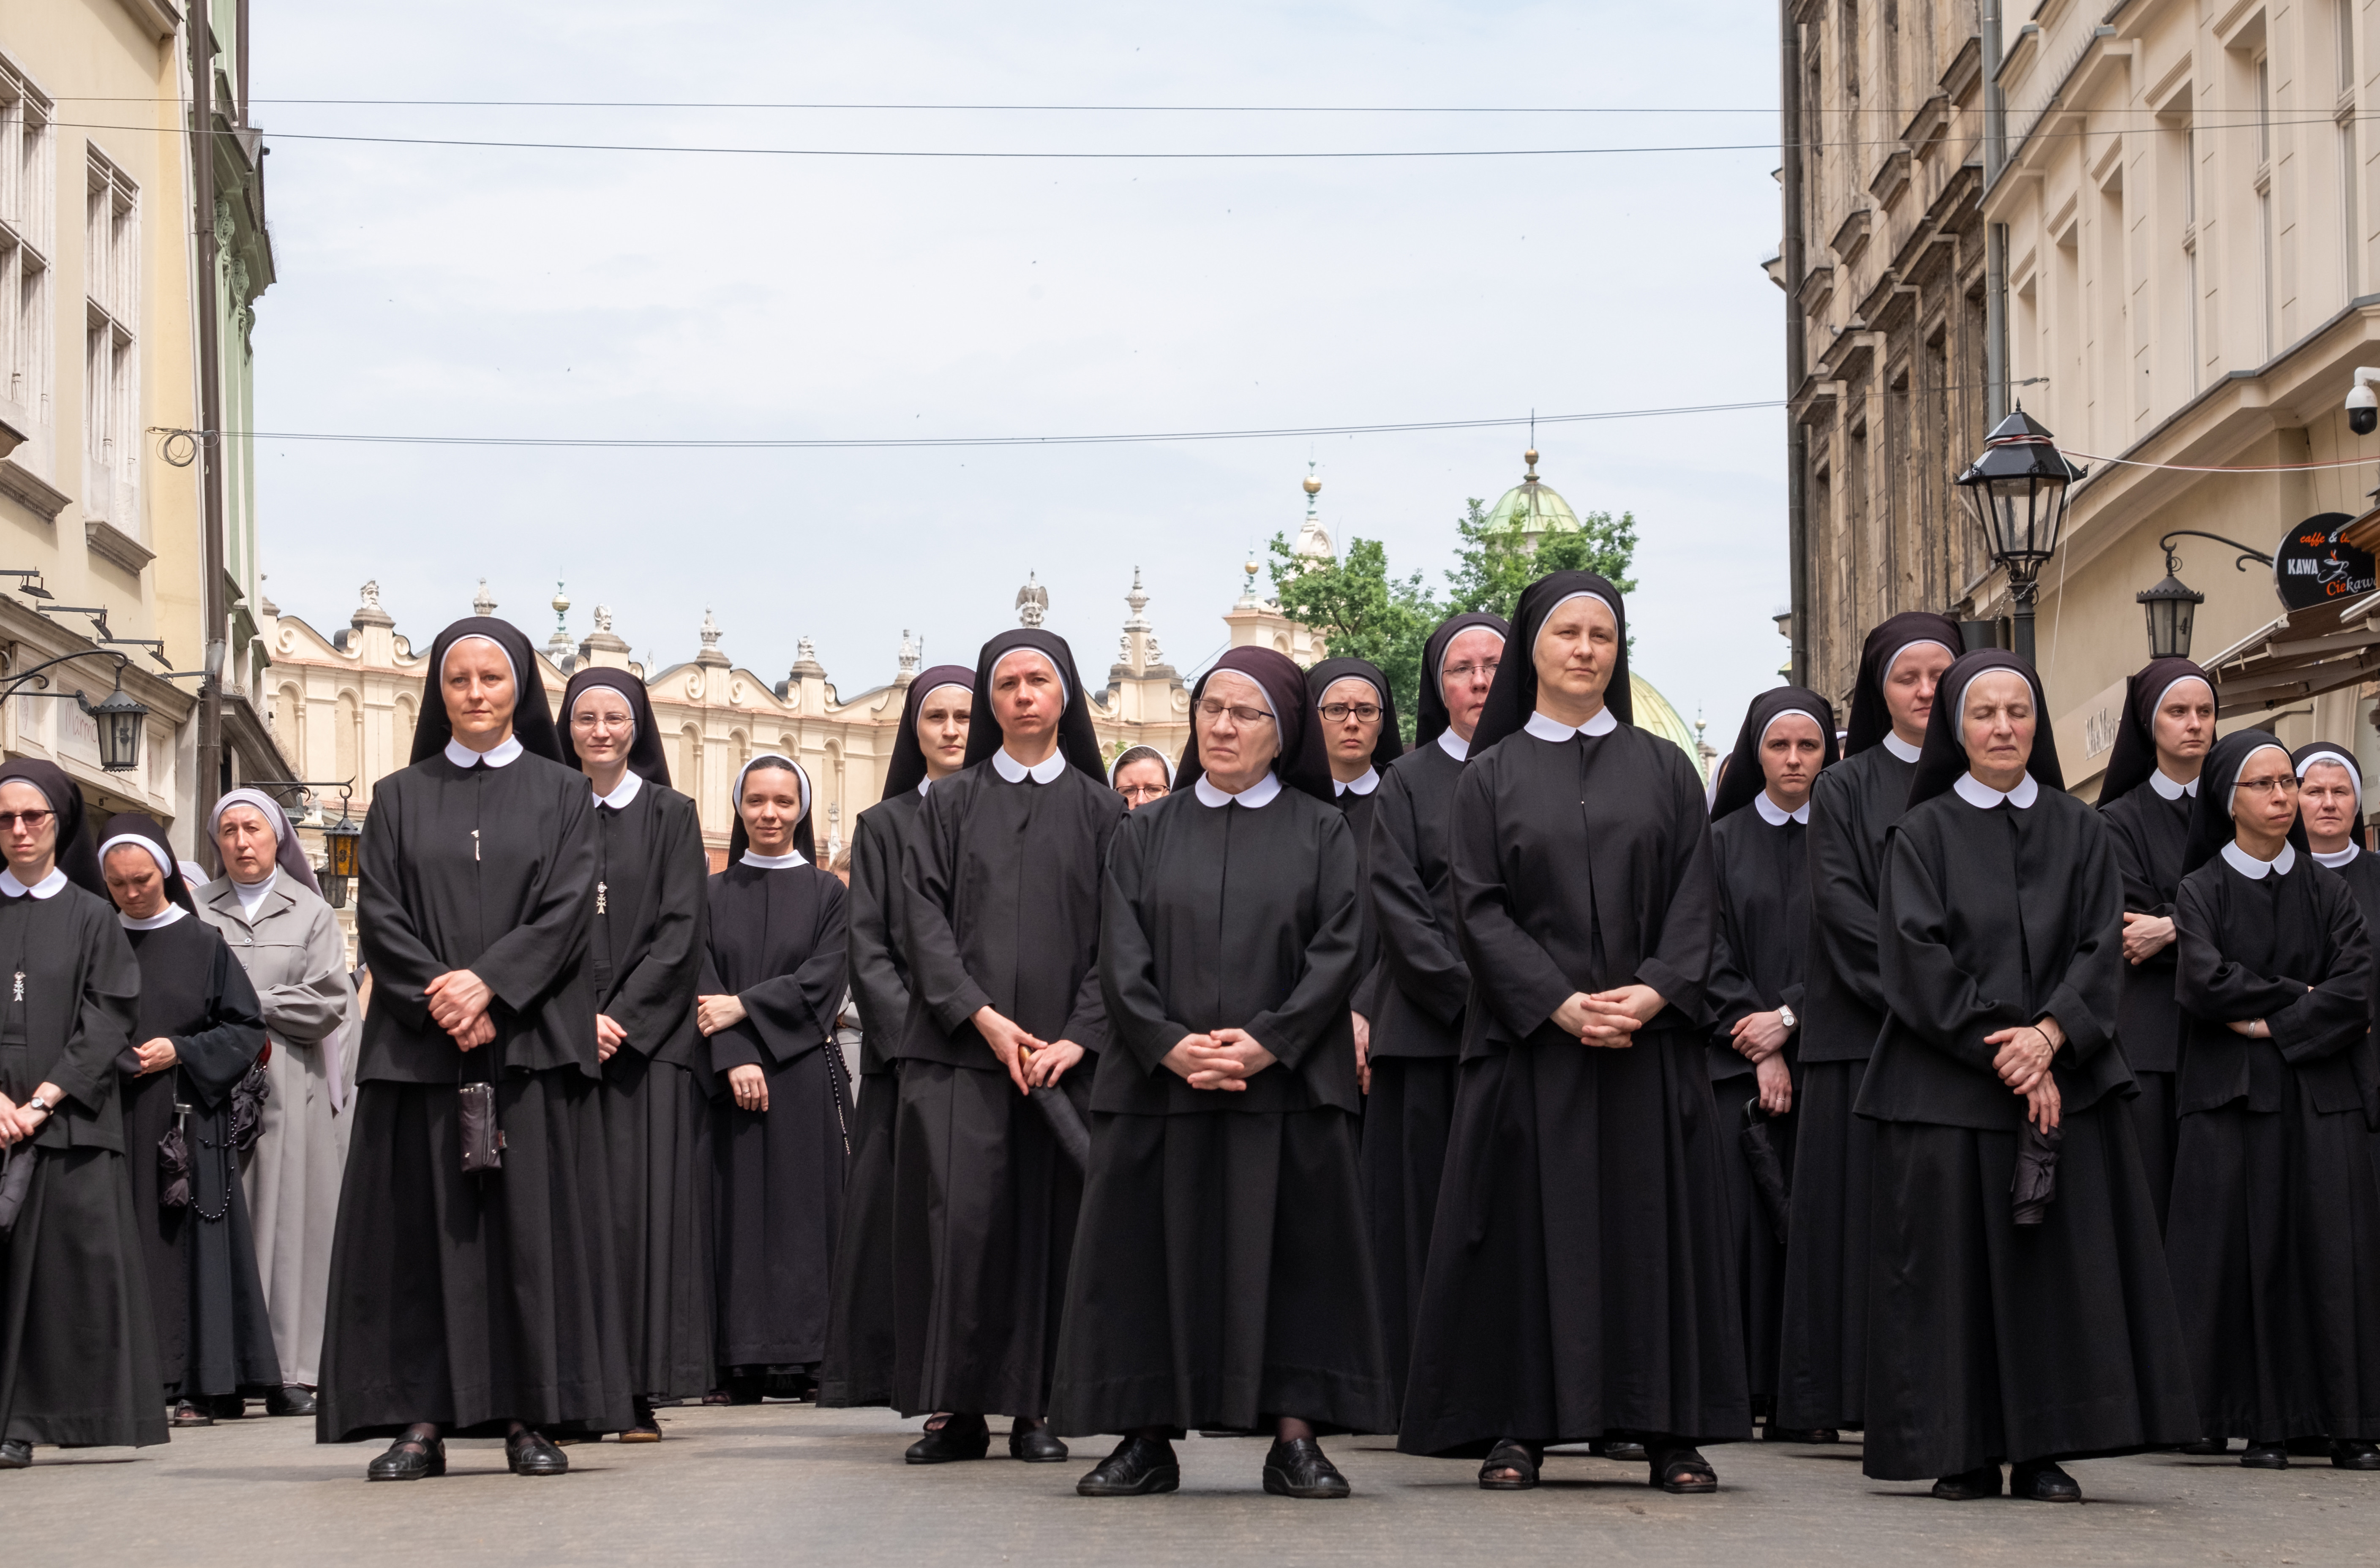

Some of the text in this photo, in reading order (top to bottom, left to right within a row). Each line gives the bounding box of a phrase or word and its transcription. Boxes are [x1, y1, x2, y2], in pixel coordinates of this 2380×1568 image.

[2300, 532, 2325, 547] caffe
[2328, 531, 2337, 543] &
[2287, 559, 2318, 574] KAWA
[2180, 617, 2188, 634] 4
[65, 701, 98, 743] Marmo
[2086, 708, 2116, 760] MaxMar
[338, 849, 347, 863] 3
